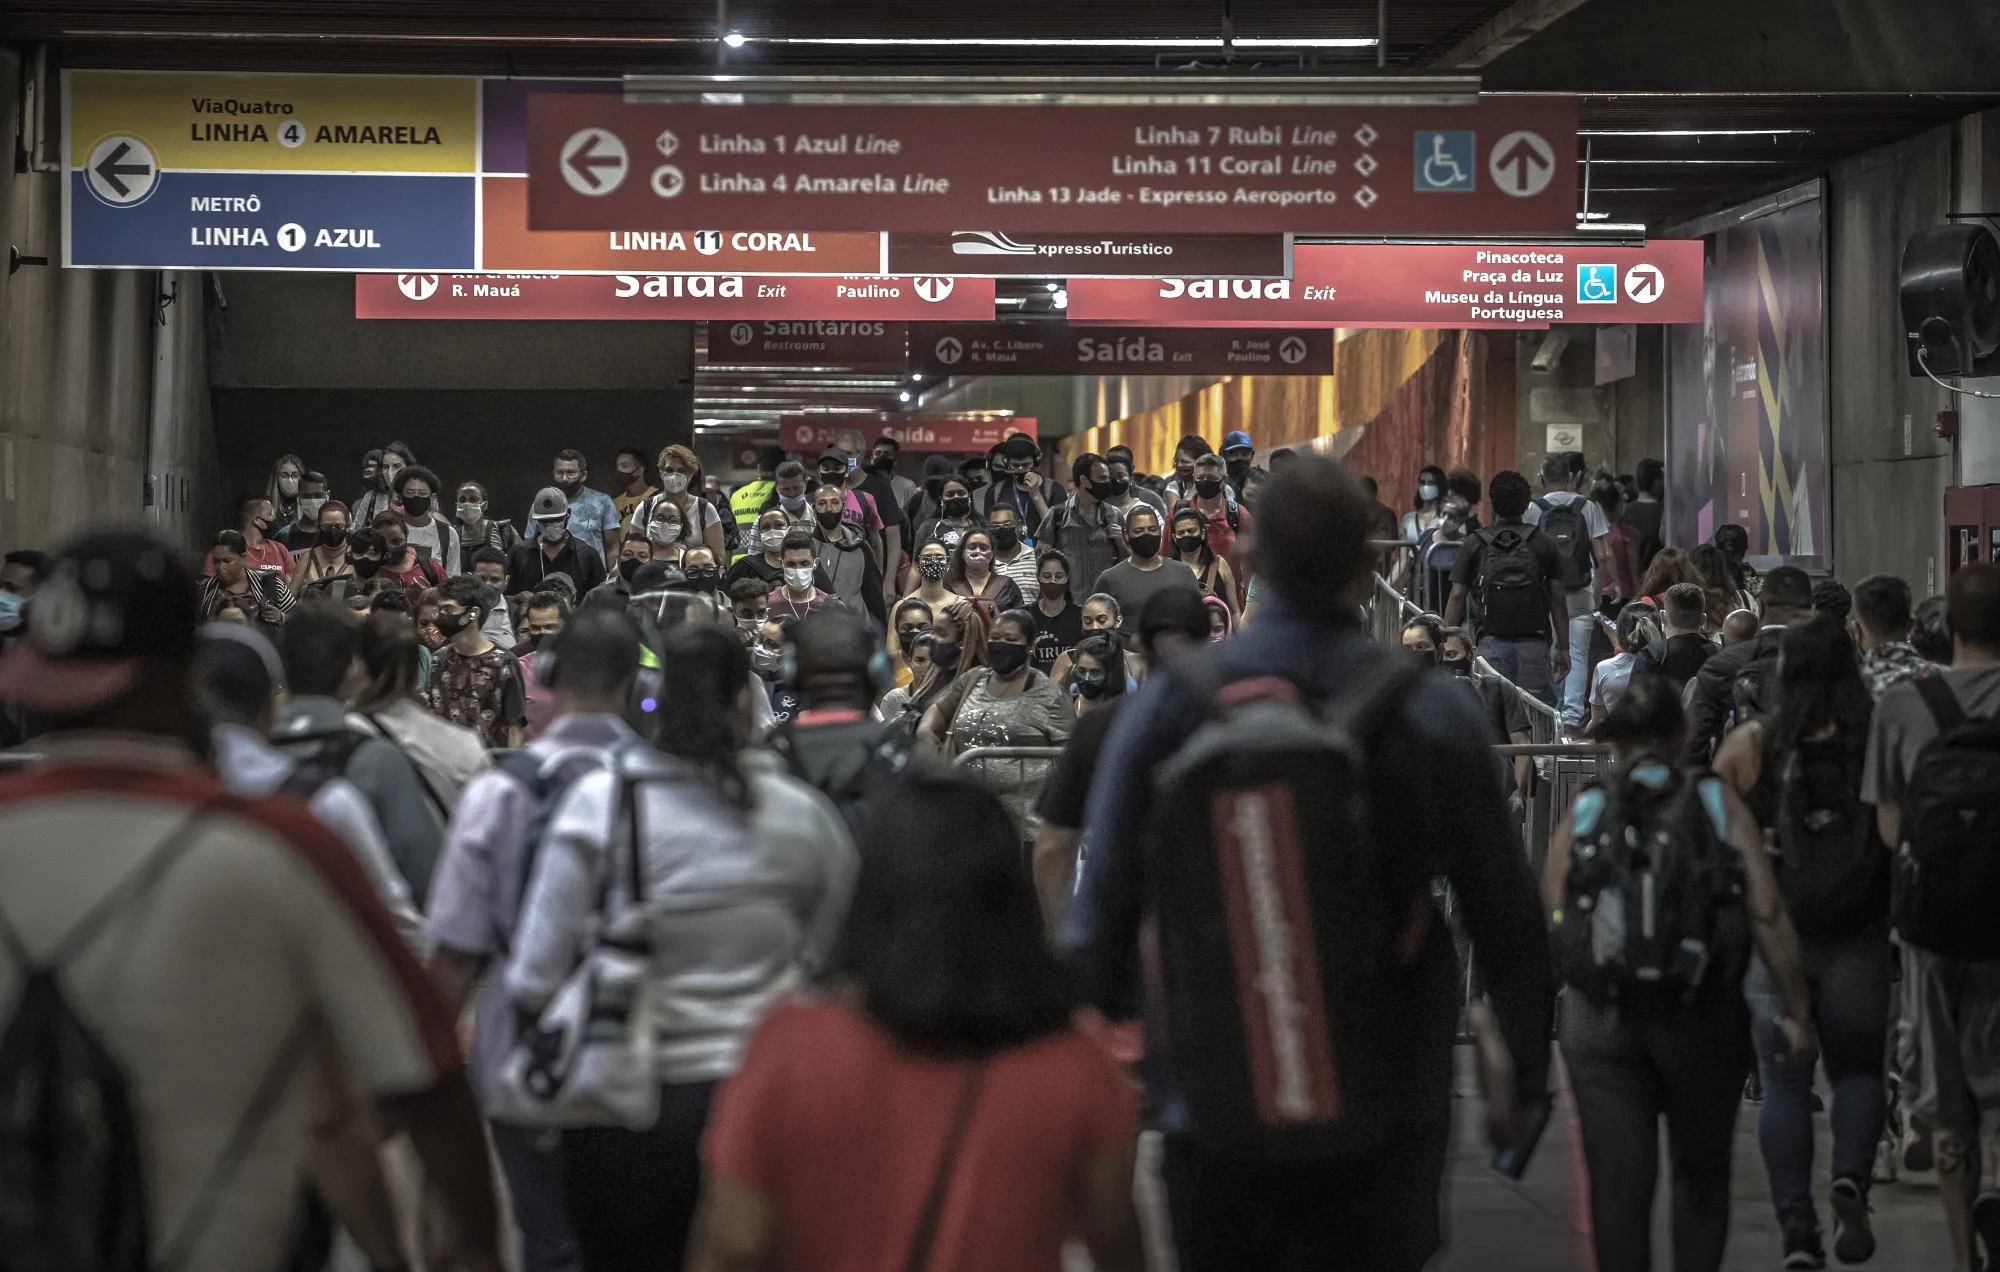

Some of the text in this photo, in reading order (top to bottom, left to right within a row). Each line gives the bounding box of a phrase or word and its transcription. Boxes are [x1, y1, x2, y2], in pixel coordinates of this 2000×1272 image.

[192, 98, 294, 117] ViaQuatro
[191, 123, 442, 145] LINHA 4 AMARELA
[1135, 125, 1338, 146] Linha 7 Rubi Line
[700, 134, 901, 155] Linha 1 Azul Line
[1112, 155, 1337, 176] Linha 11 Coral Line
[700, 173, 949, 194] Linha 4 Amarela Line
[191, 193, 261, 213] METRÔ
[987, 186, 1042, 204] Linha
[1048, 187, 1071, 203] 13
[1076, 186, 1122, 204] Jade
[1139, 187, 1228, 207] Expresso
[1232, 187, 1337, 208] Aeroporto
[191, 227, 270, 247] LINHA
[313, 228, 381, 248] AZUL
[609, 231, 816, 252] LINHA 11 CORAL
[1476, 250, 1564, 264] Pinacoteca
[1462, 268, 1564, 286] Praça da Luz
[452, 283, 521, 297] R. Mauá
[757, 284, 787, 298] Exit
[836, 284, 900, 298] Paulino
[1303, 285, 1337, 301] Exit
[1425, 290, 1564, 307] Museu da Língua
[1471, 306, 1564, 323] Portuguesa
[763, 340, 826, 351] Restrooms
[1077, 335, 1193, 363] Saída Exit
[1227, 351, 1271, 363] Paulino
